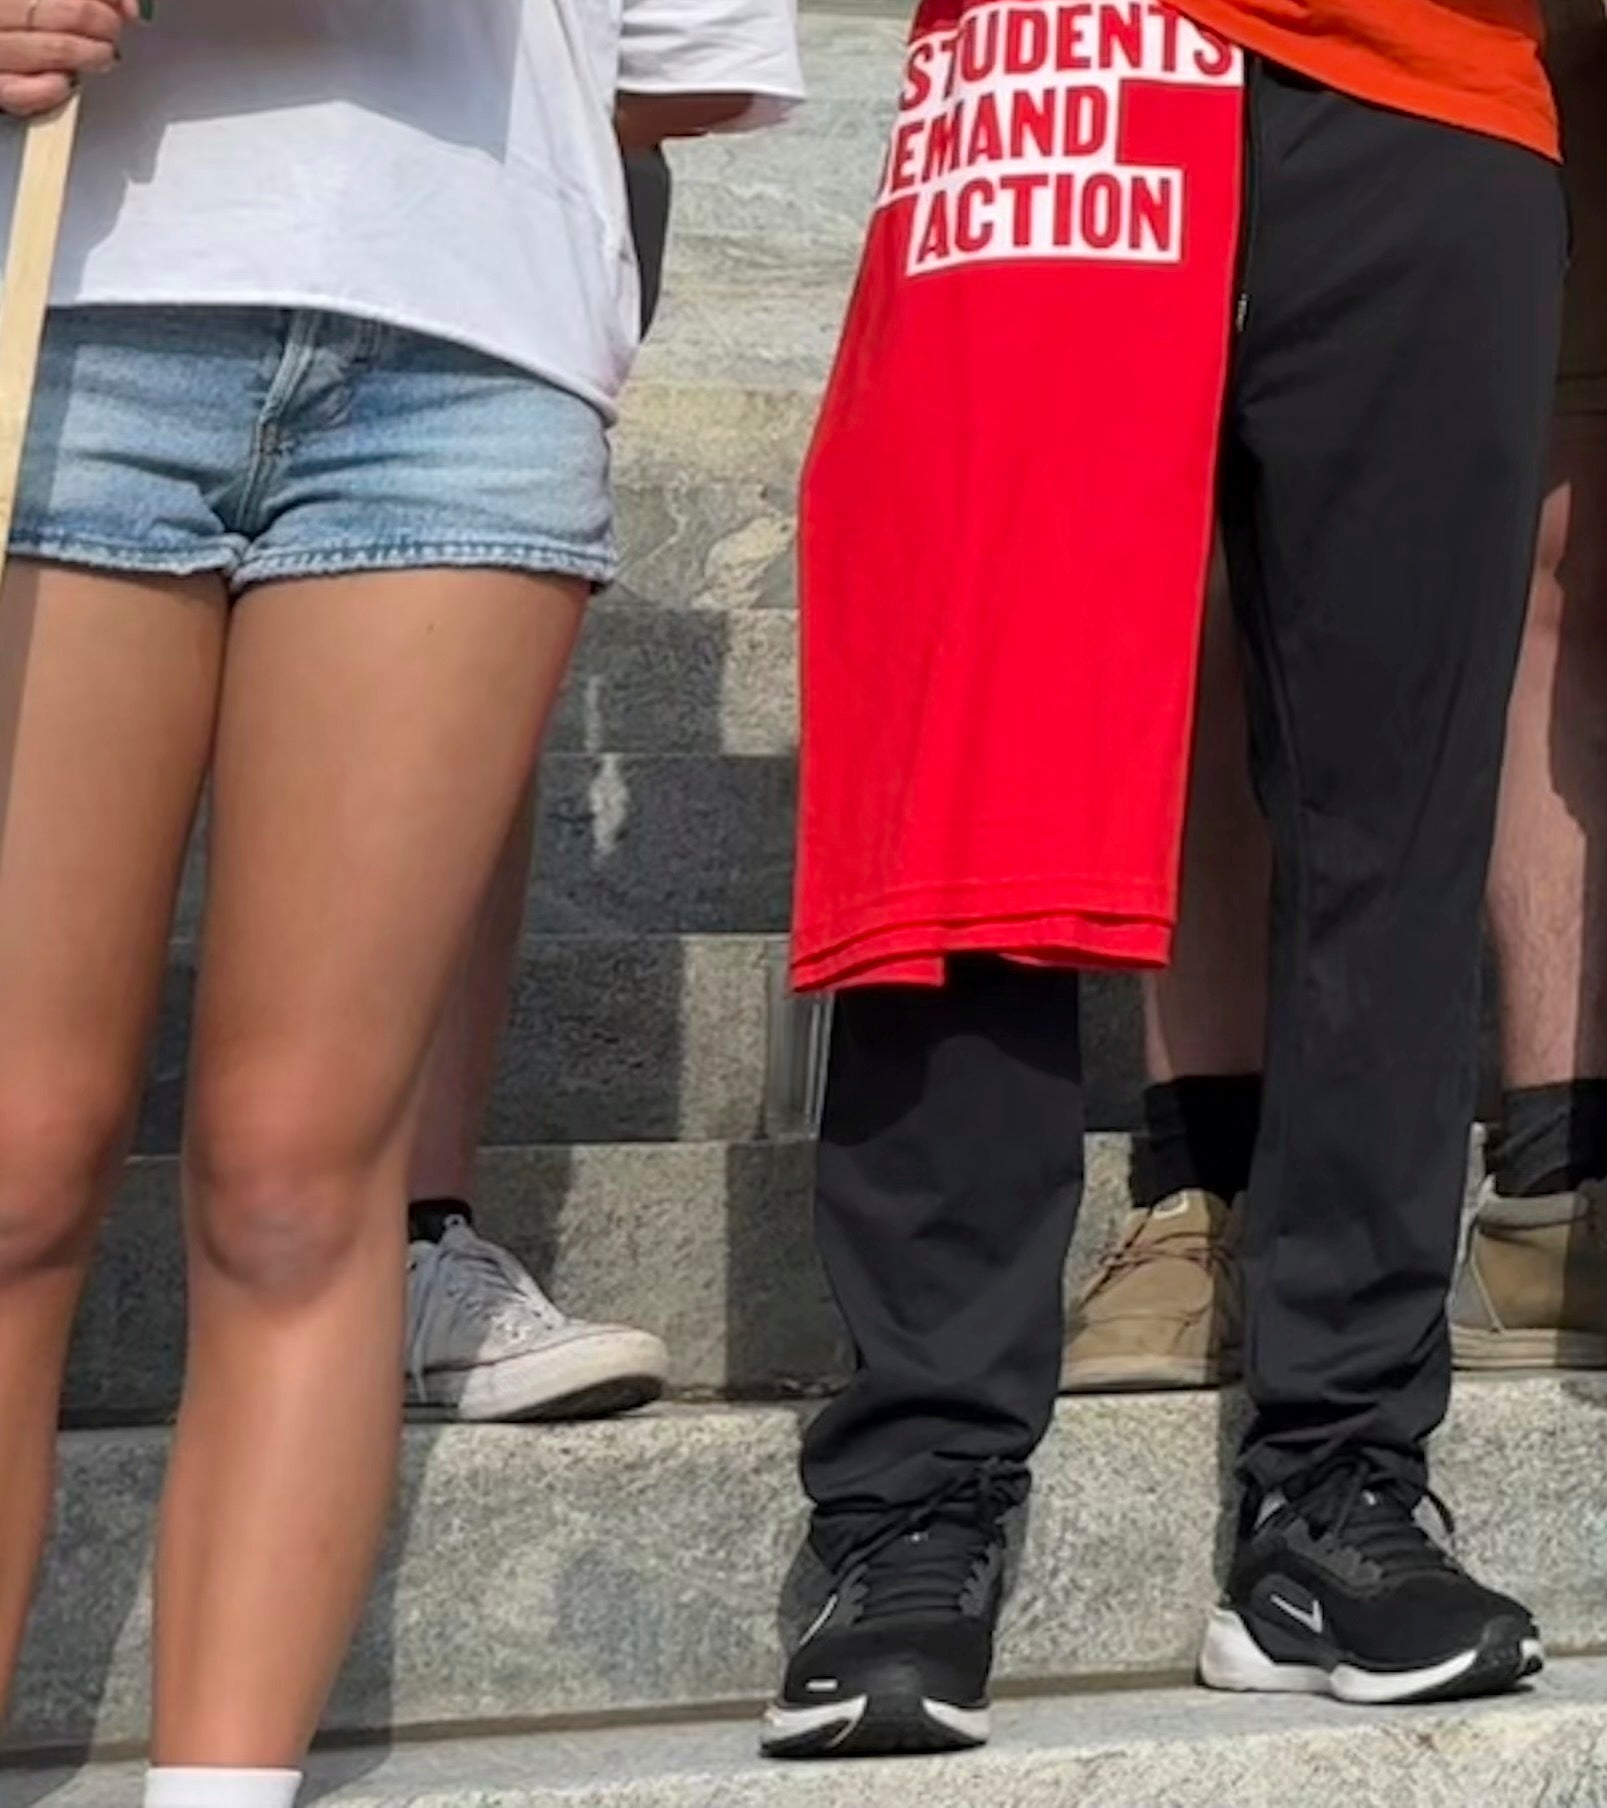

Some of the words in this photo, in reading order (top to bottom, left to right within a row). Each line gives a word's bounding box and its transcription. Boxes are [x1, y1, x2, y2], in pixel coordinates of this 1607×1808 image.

[901, 2, 1234, 112] STUDENTS
[880, 84, 1109, 193] EMAND
[916, 172, 1171, 263] ACTION
